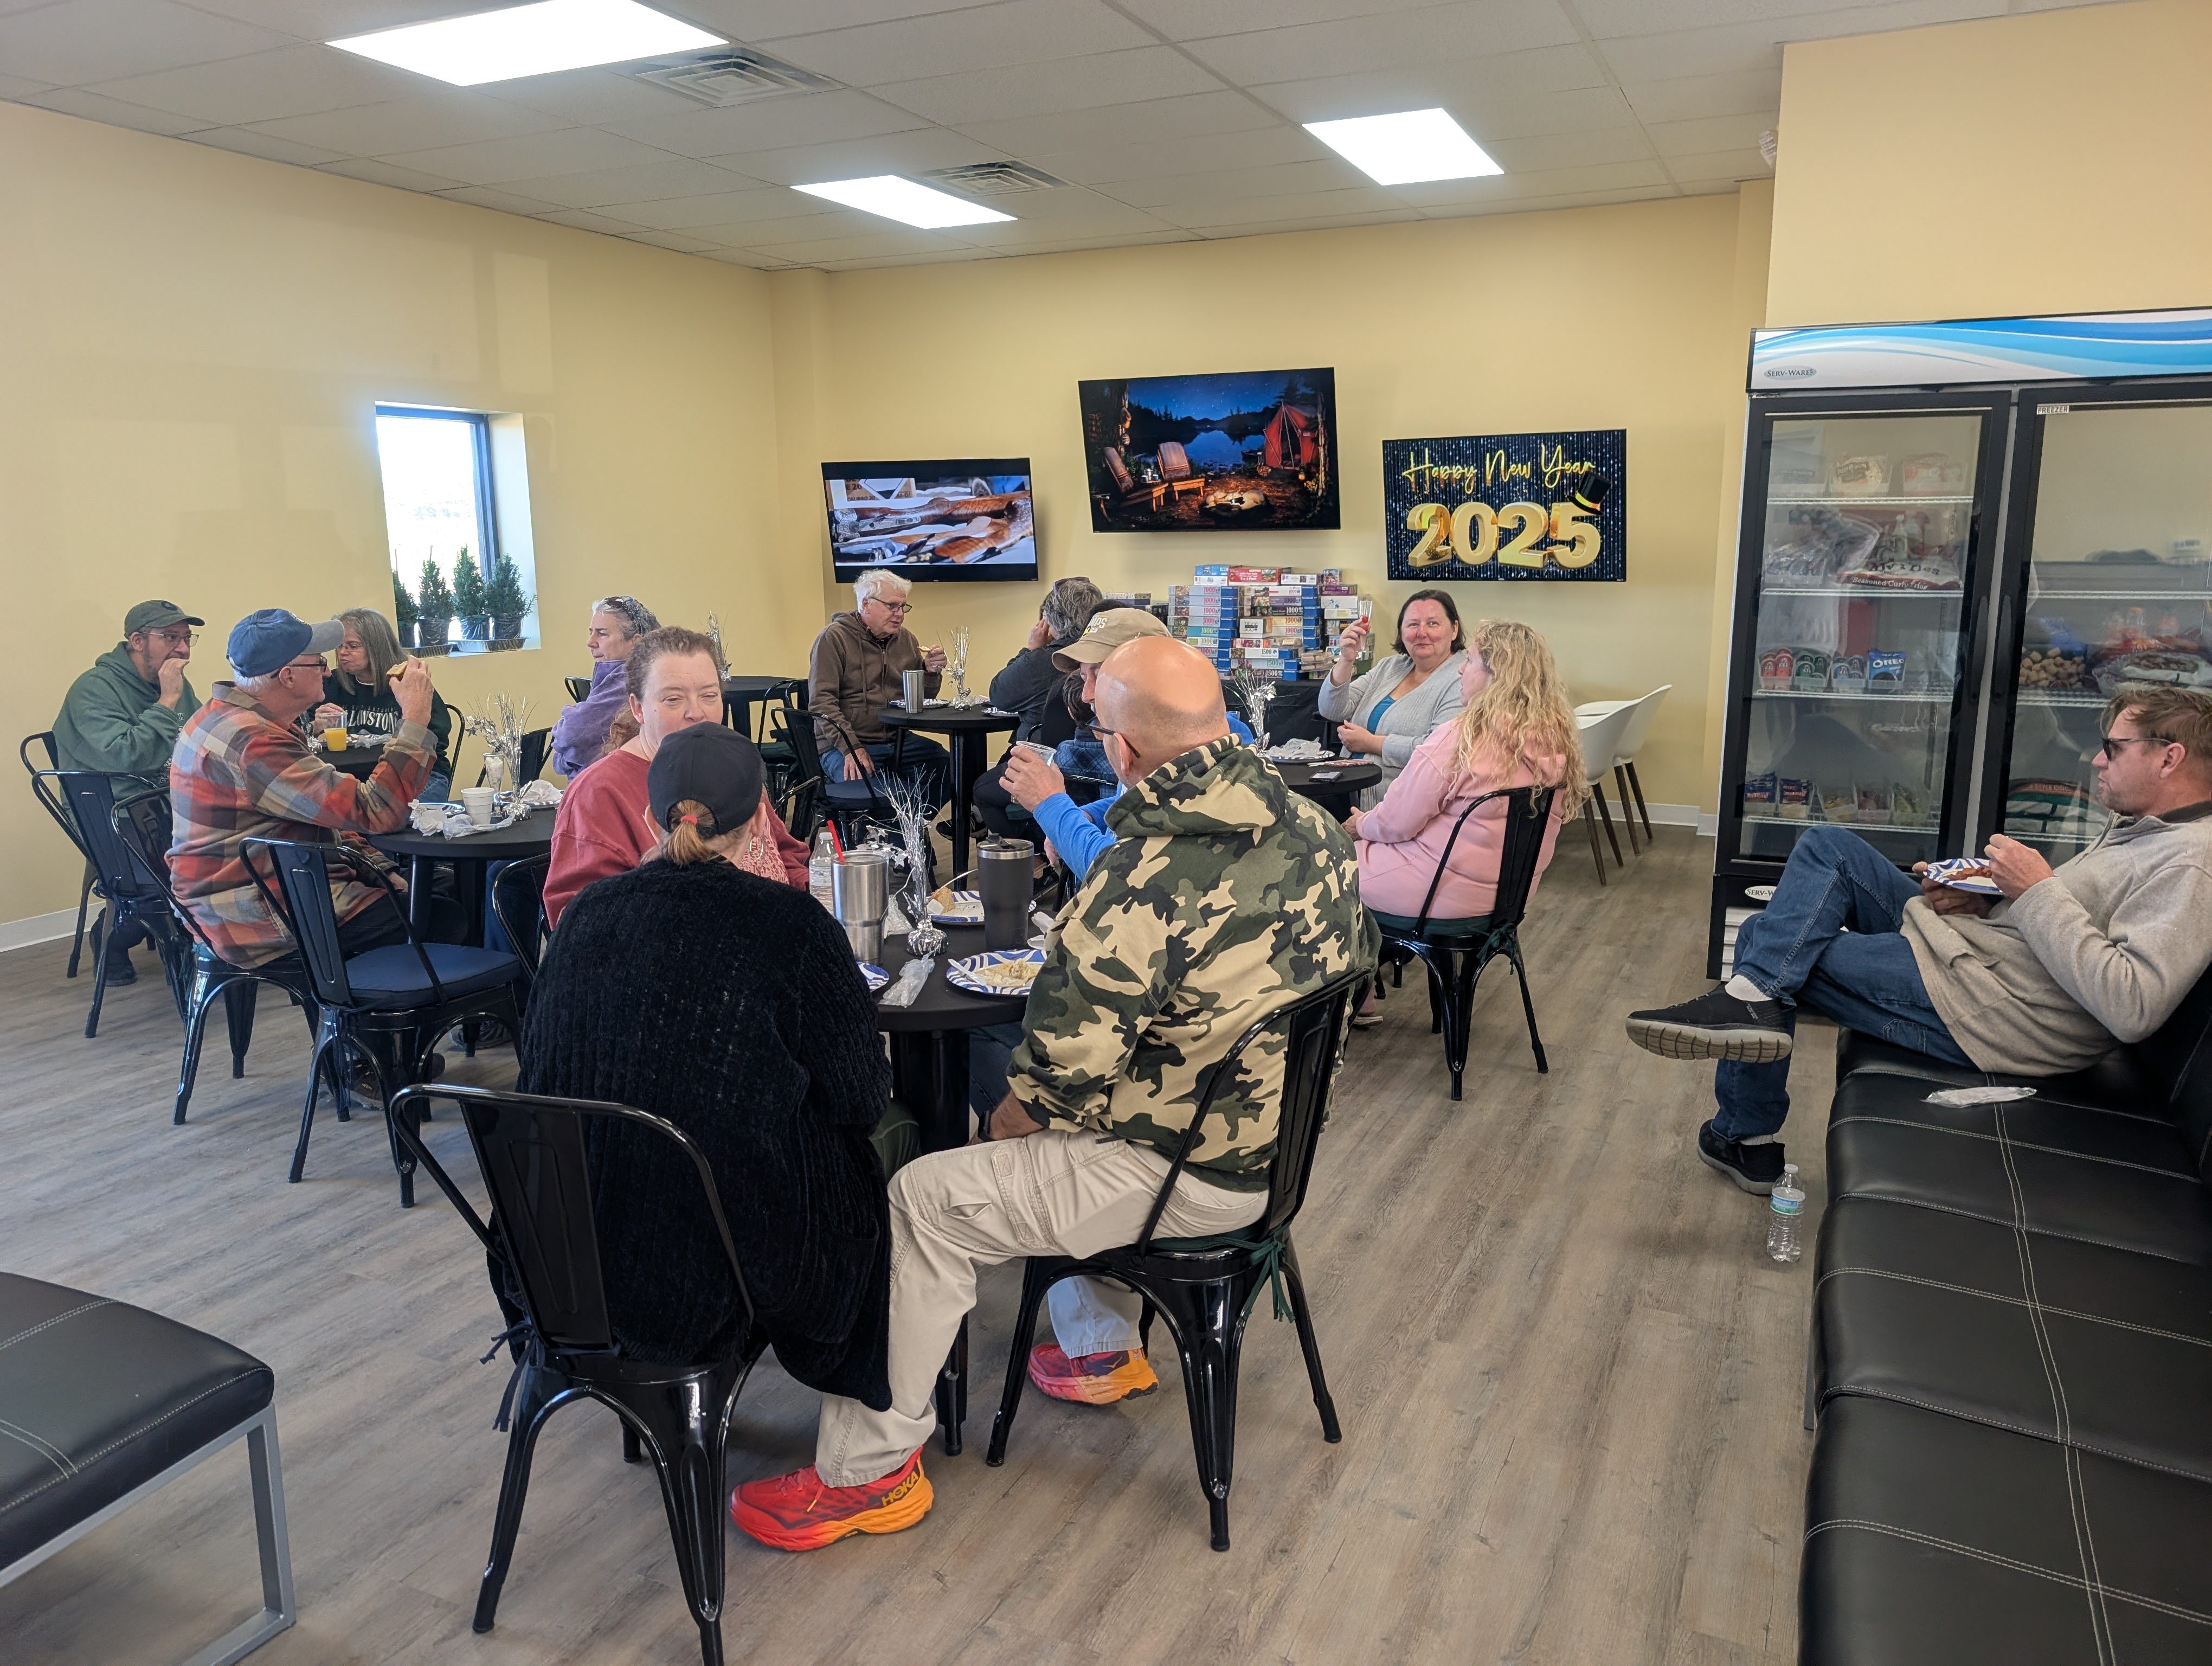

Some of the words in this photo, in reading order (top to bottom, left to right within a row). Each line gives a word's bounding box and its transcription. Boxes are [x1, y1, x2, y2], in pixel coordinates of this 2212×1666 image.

[2039, 405, 2068, 413] FREEZER
[1402, 448, 1477, 494] Happy
[1486, 450, 1531, 486] New
[1541, 444, 1596, 488] Year
[1407, 502, 1601, 568] 2025
[1853, 577, 1887, 586] Seasoned
[1873, 658, 1905, 668] OREO
[1747, 888, 1774, 896] SERV-W
[881, 1471, 919, 1507] HOKA
